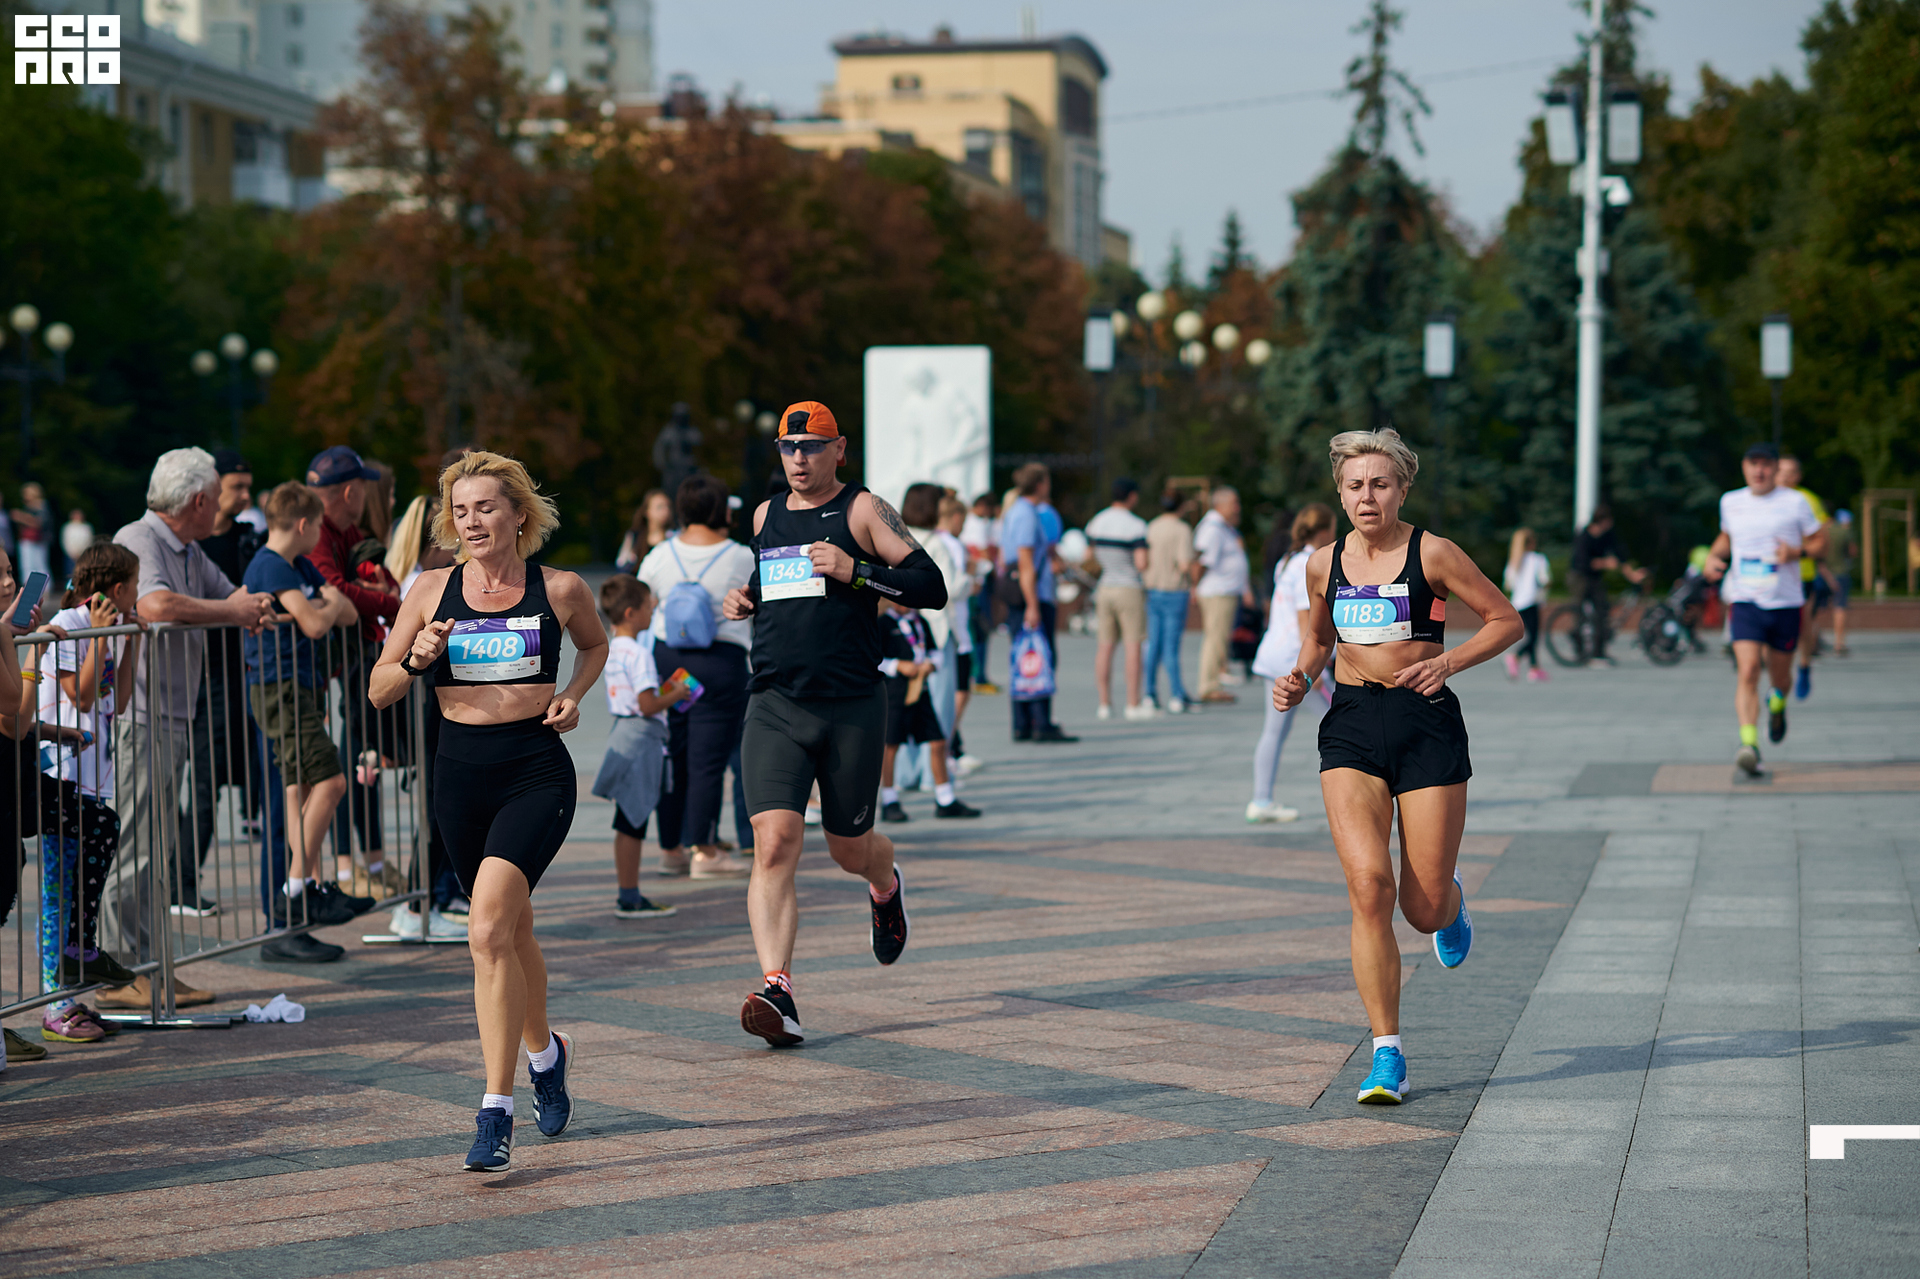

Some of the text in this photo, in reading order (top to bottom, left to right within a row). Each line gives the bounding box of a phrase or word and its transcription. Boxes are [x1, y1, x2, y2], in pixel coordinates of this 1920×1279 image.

[768, 561, 807, 582] 1345
[1343, 603, 1385, 624] 1183
[461, 636, 518, 660] 1408
